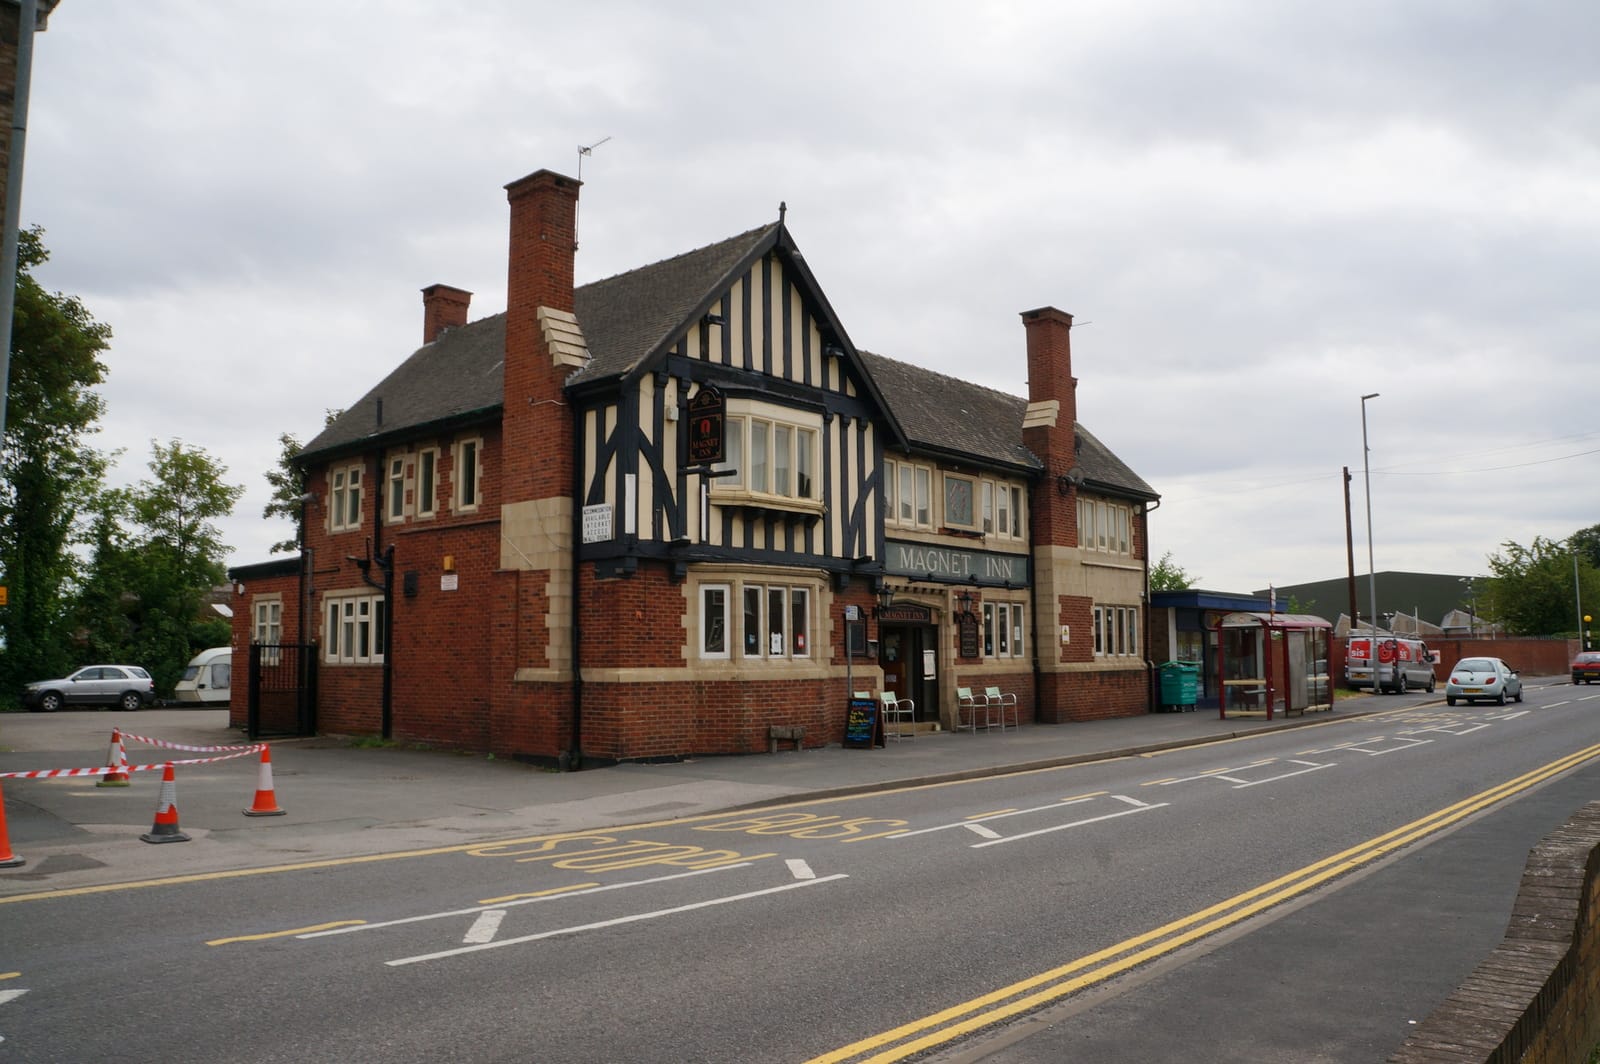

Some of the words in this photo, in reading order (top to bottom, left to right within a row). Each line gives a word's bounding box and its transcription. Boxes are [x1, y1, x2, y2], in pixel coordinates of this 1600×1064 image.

[692, 438, 718, 448] MAGNET
[584, 520, 610, 529] INTERNET
[900, 547, 971, 575] MAGNET
[985, 556, 1013, 578] INN
[1351, 648, 1365, 657] sis
[692, 812, 908, 840] BUS
[465, 835, 742, 874] STOP
